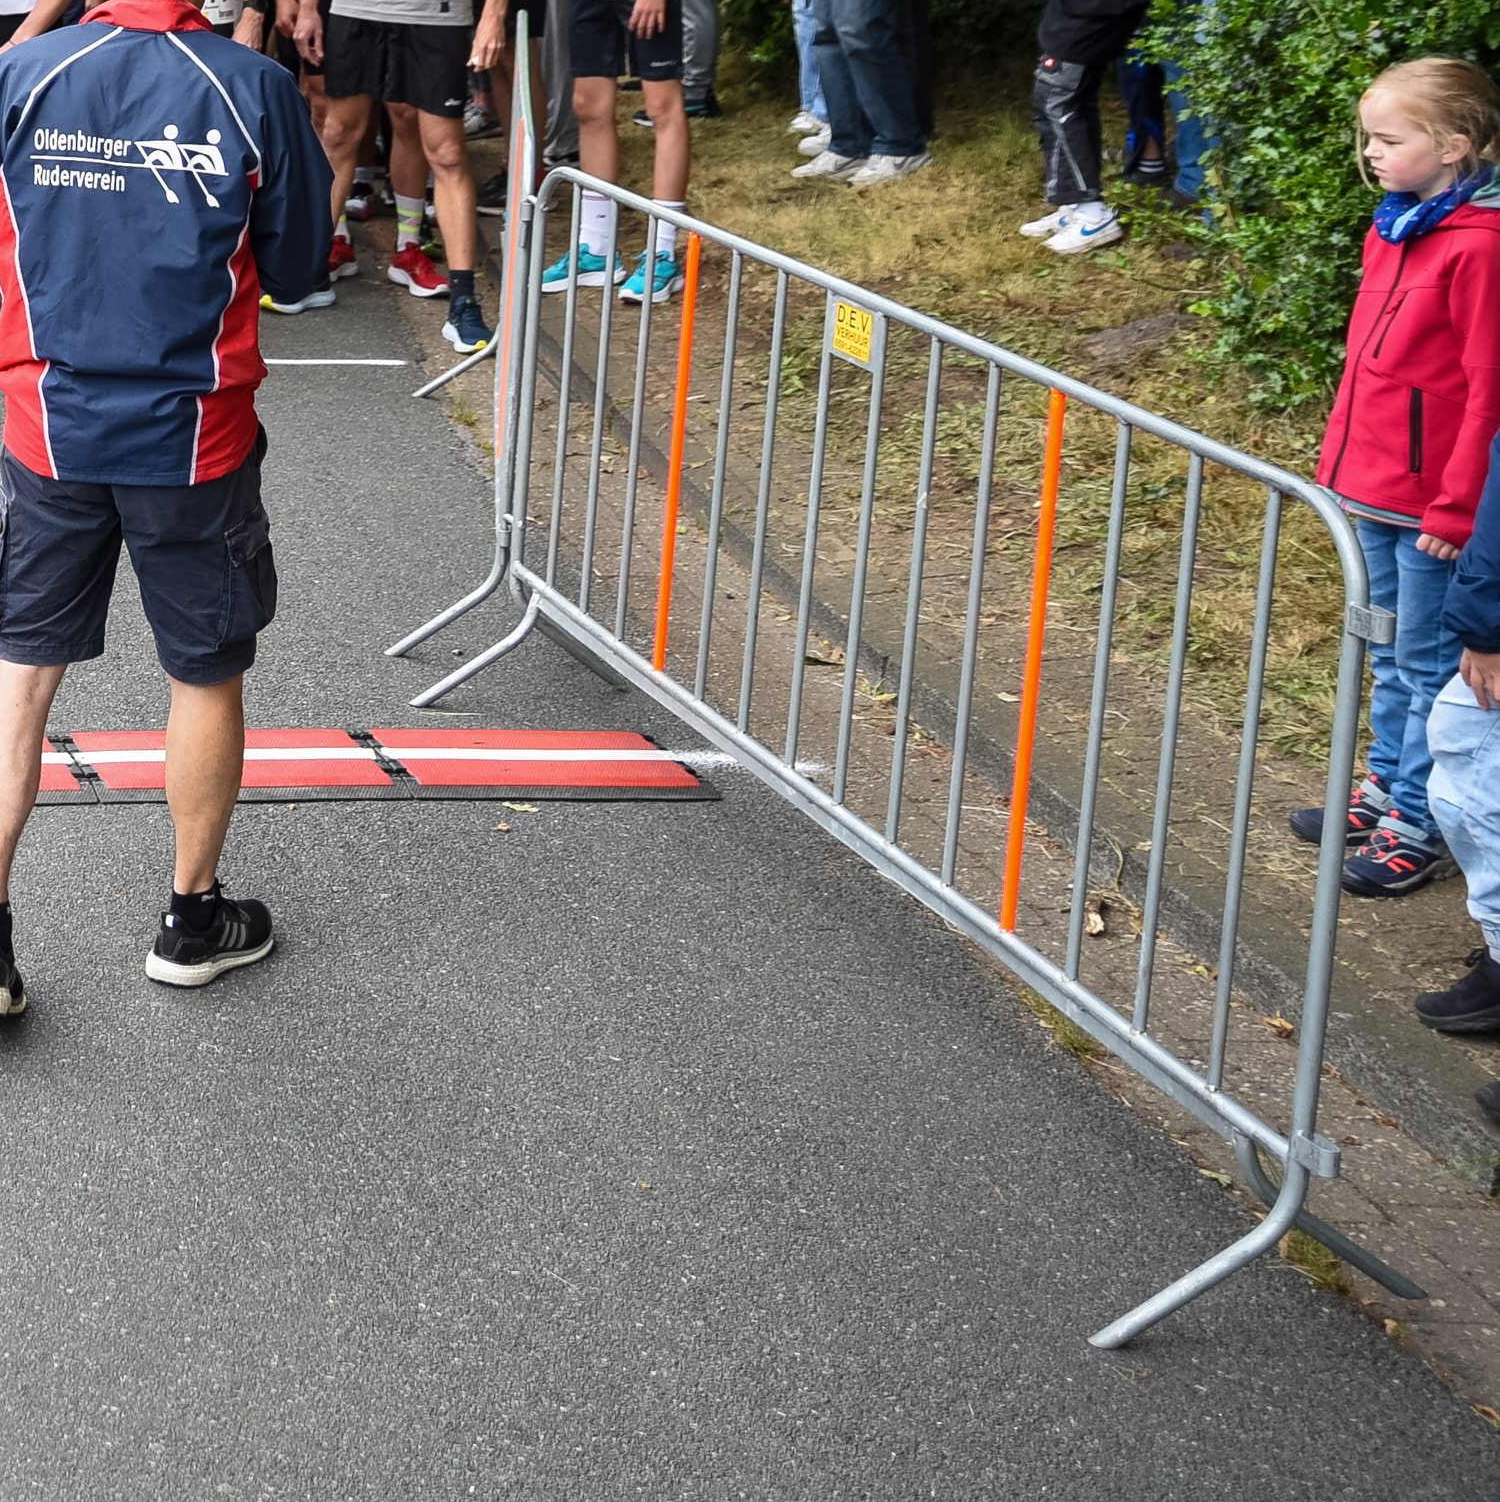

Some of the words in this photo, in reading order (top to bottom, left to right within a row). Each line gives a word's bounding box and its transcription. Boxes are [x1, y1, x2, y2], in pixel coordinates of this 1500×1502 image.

[33, 128, 132, 157] Oldenburger
[33, 163, 126, 192] Ruderverein
[837, 304, 870, 335] D.E.V.
